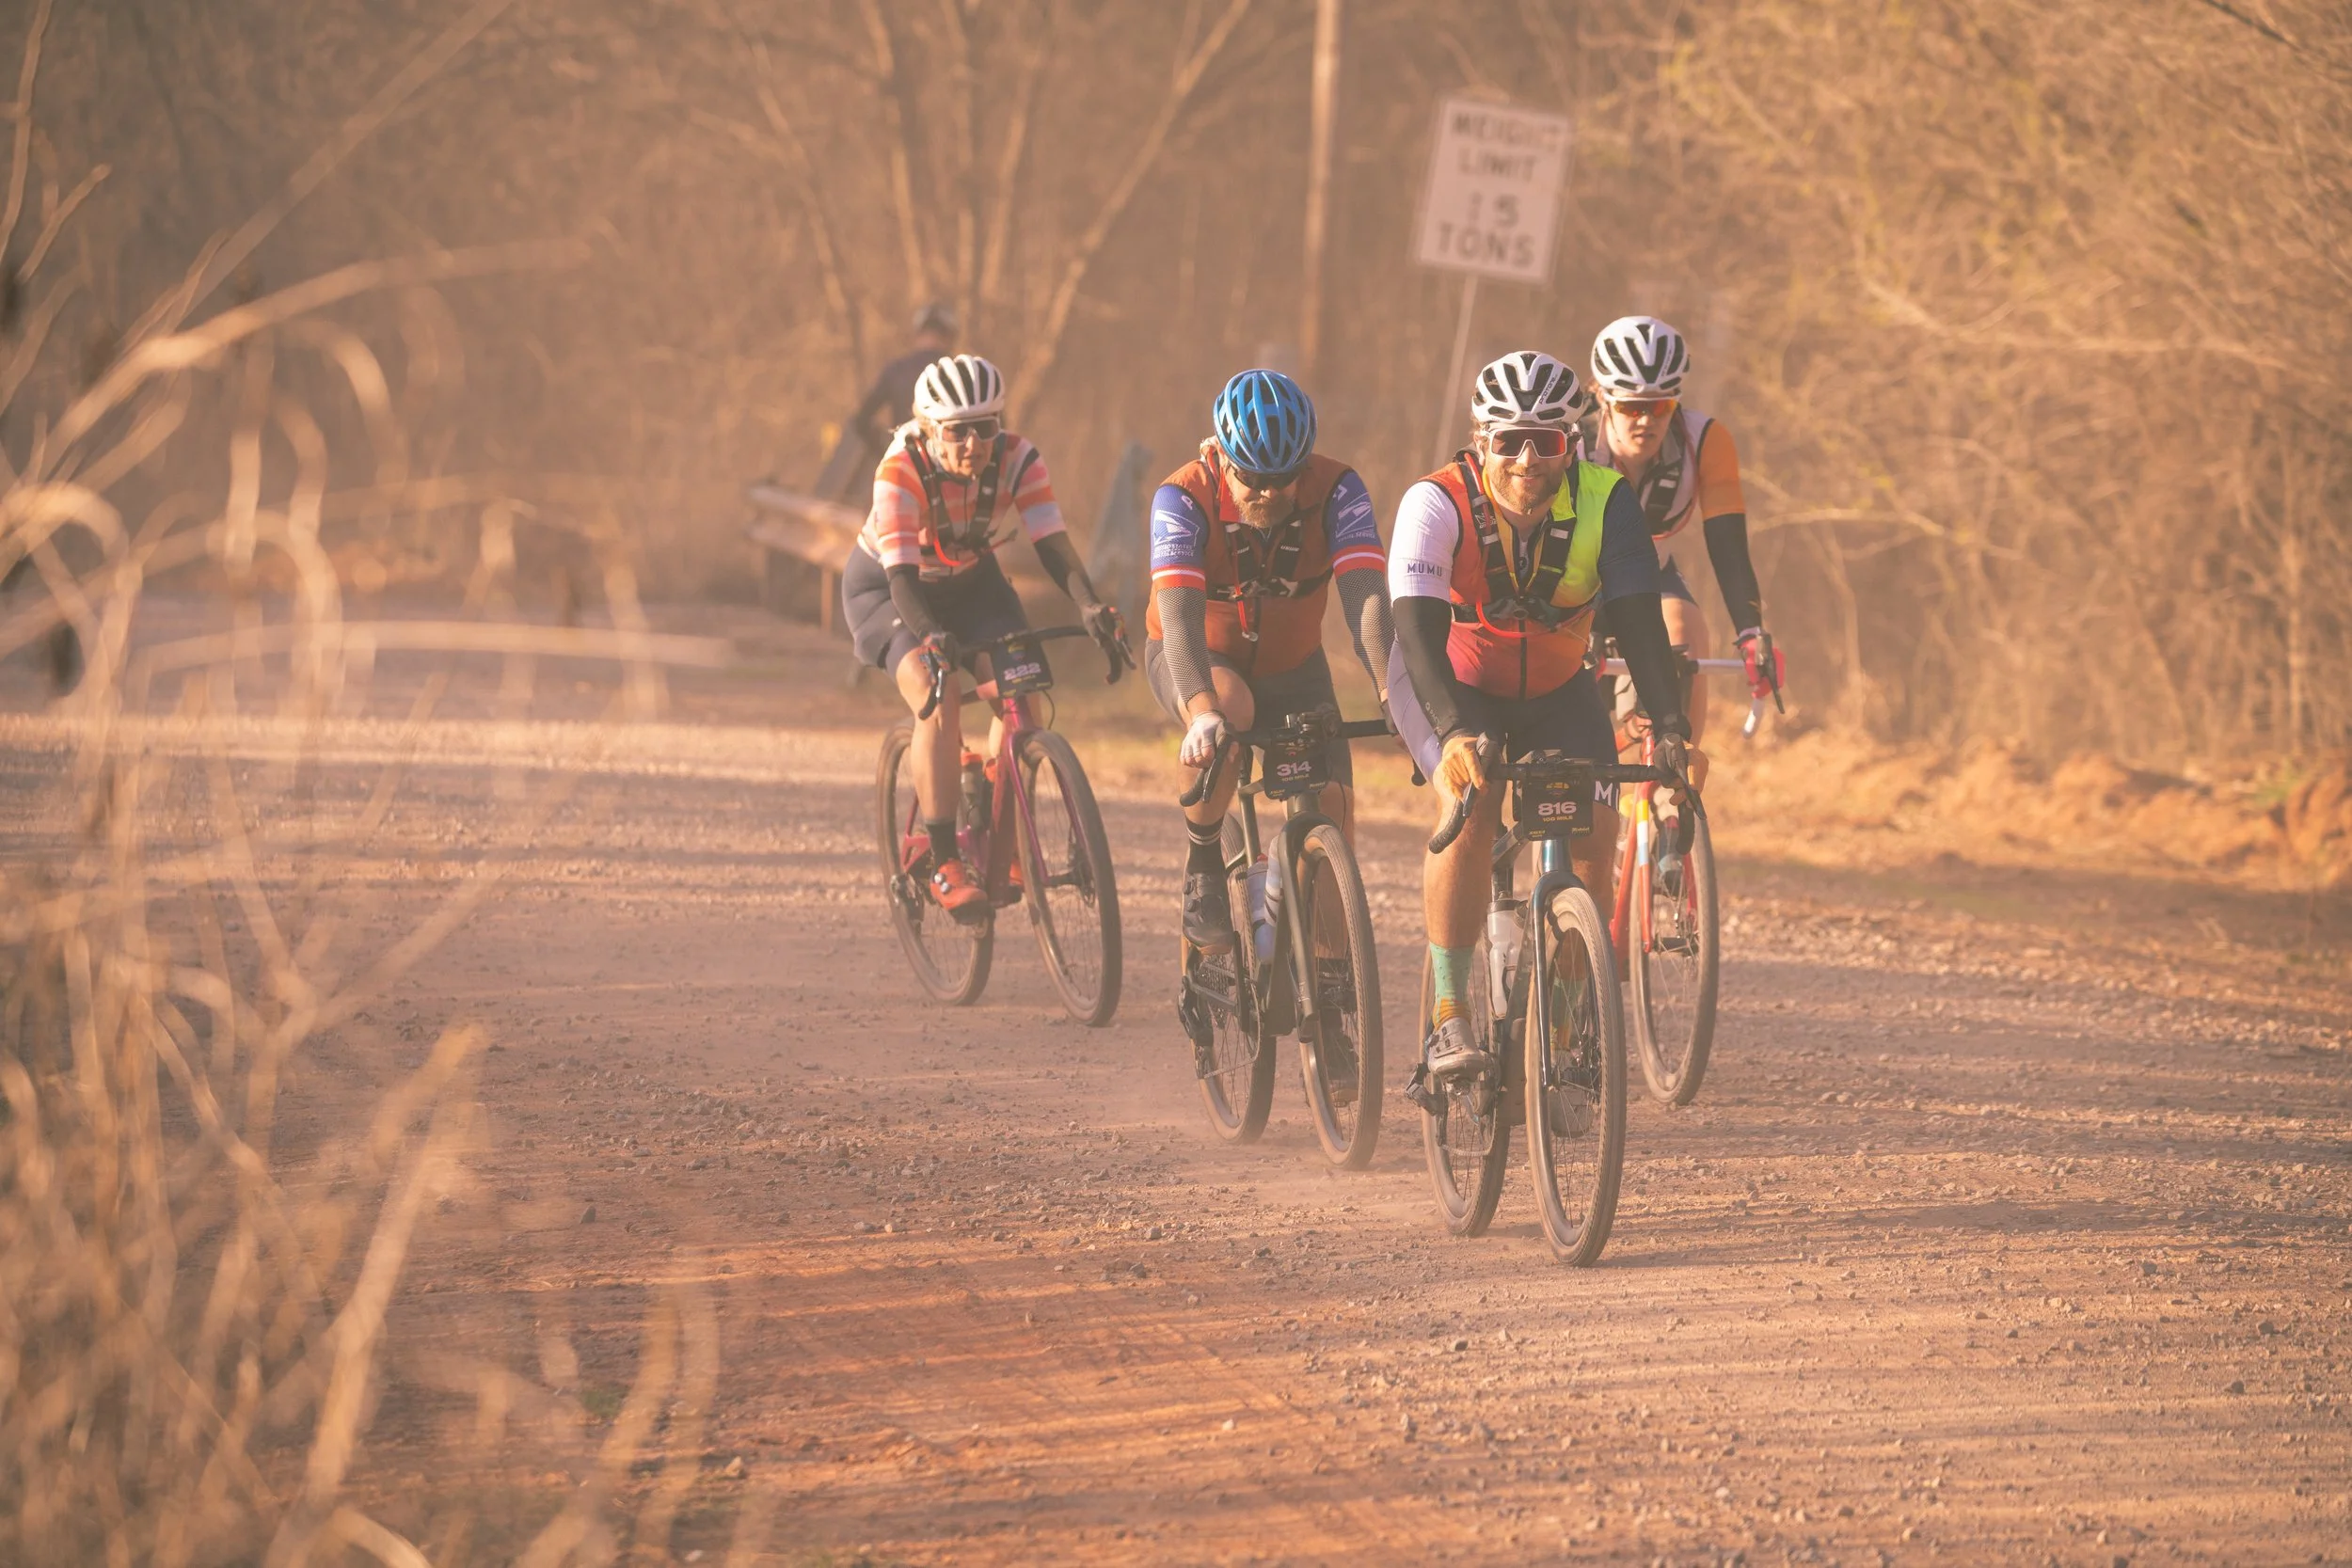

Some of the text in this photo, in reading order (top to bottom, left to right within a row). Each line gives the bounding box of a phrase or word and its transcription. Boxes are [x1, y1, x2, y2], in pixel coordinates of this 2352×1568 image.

[1459, 147, 1538, 182] LIMIT
[1468, 191, 1519, 229] 15
[1438, 218, 1535, 270] TONS
[1406, 562, 1442, 577] MUMU
[1004, 662, 1041, 681] 222
[1277, 761, 1311, 777] 314
[1538, 801, 1577, 816] 816
